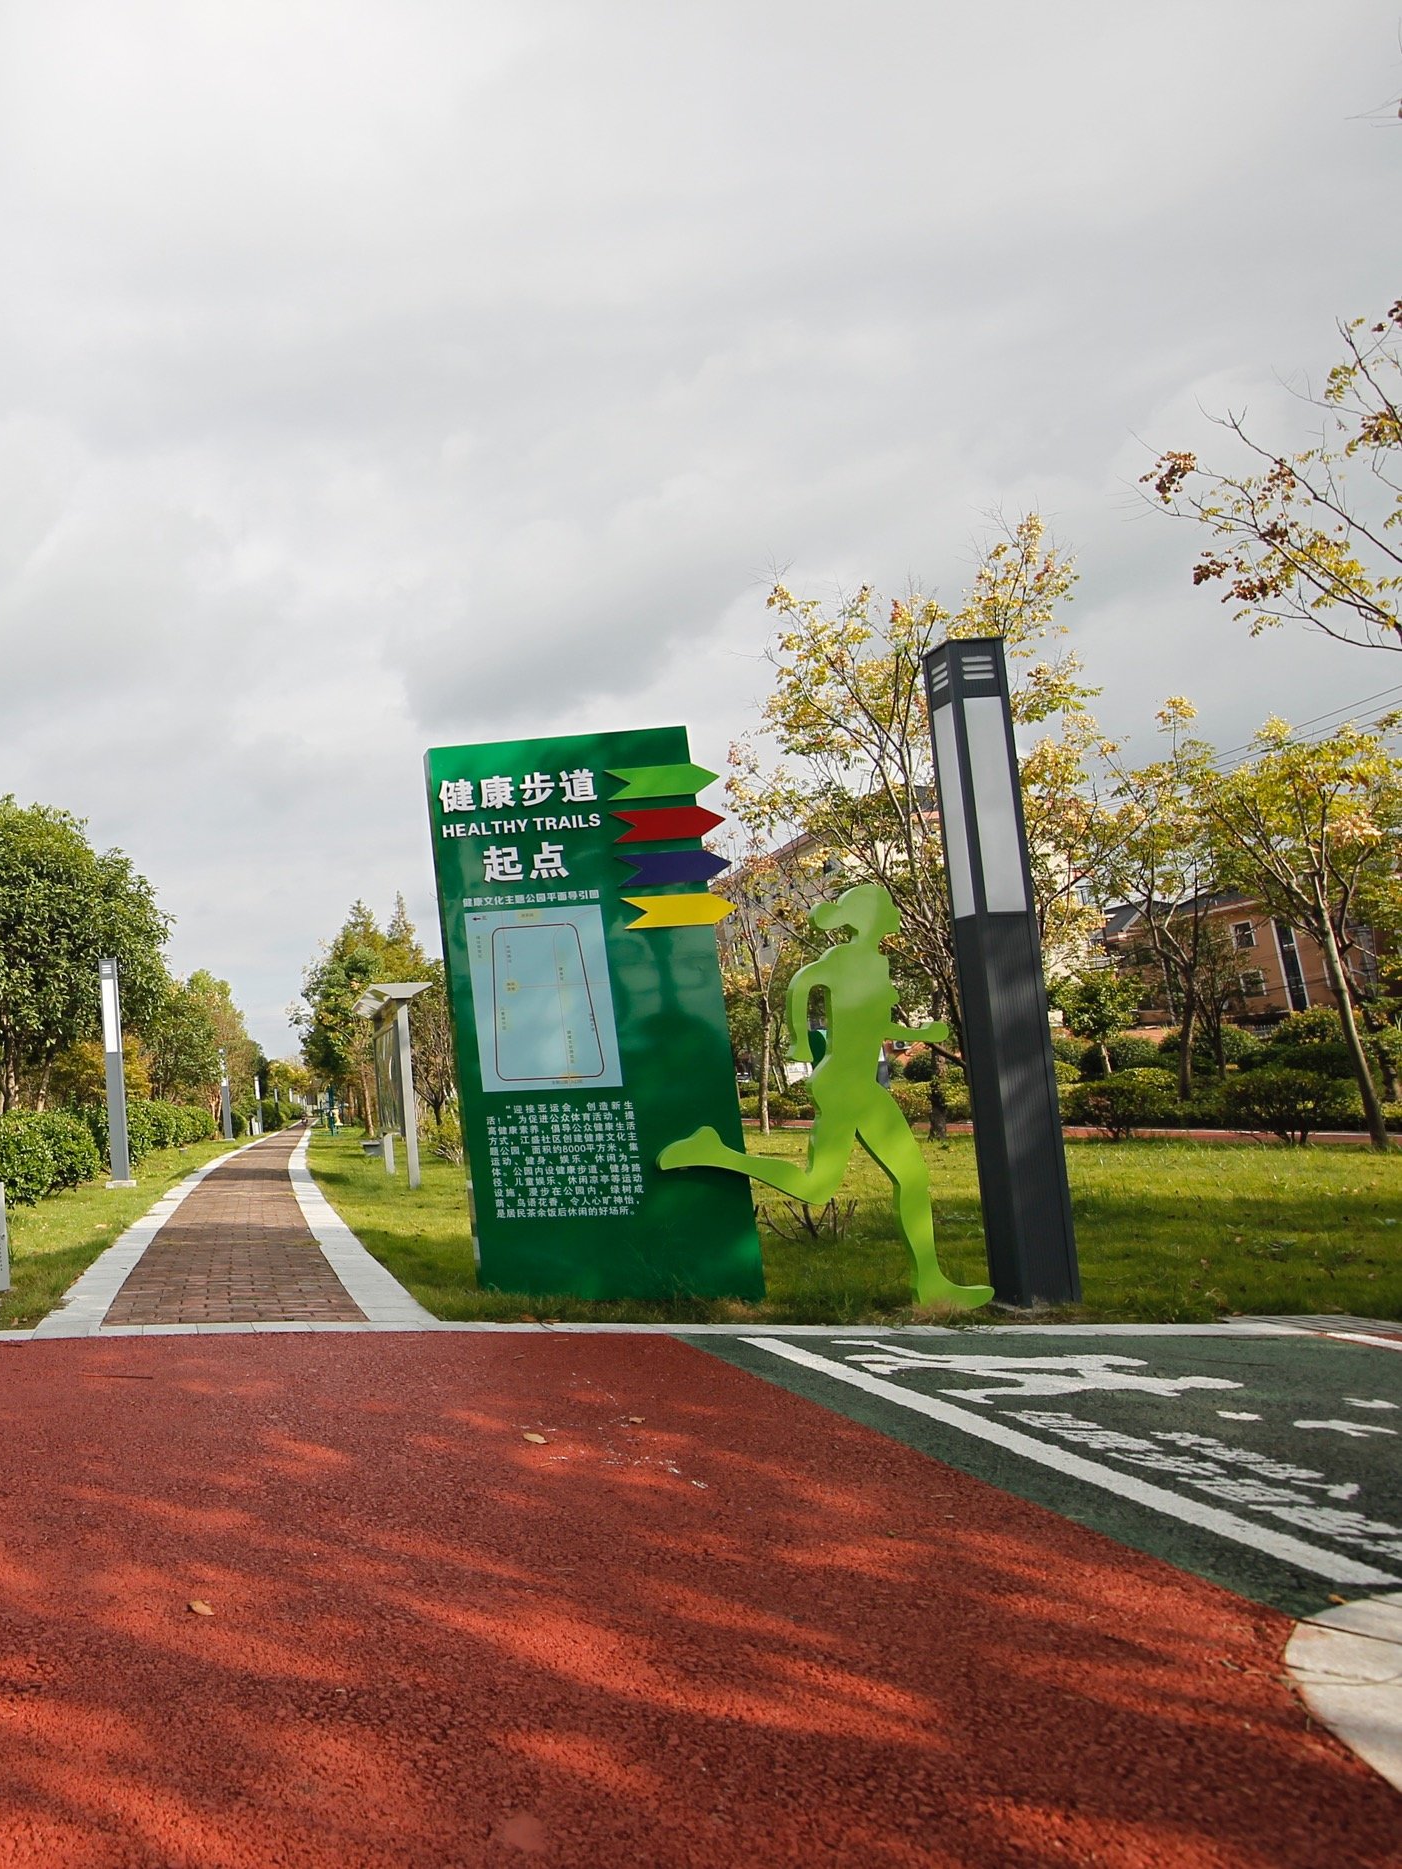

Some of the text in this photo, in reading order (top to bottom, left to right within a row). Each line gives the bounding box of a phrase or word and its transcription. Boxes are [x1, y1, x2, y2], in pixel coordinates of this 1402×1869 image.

[439, 769, 598, 813] 健康步道
[442, 813, 601, 838] HEALTHY TRAILS
[483, 841, 570, 882] 起点
[463, 889, 600, 908] 健康文化主题公园平面导引图
